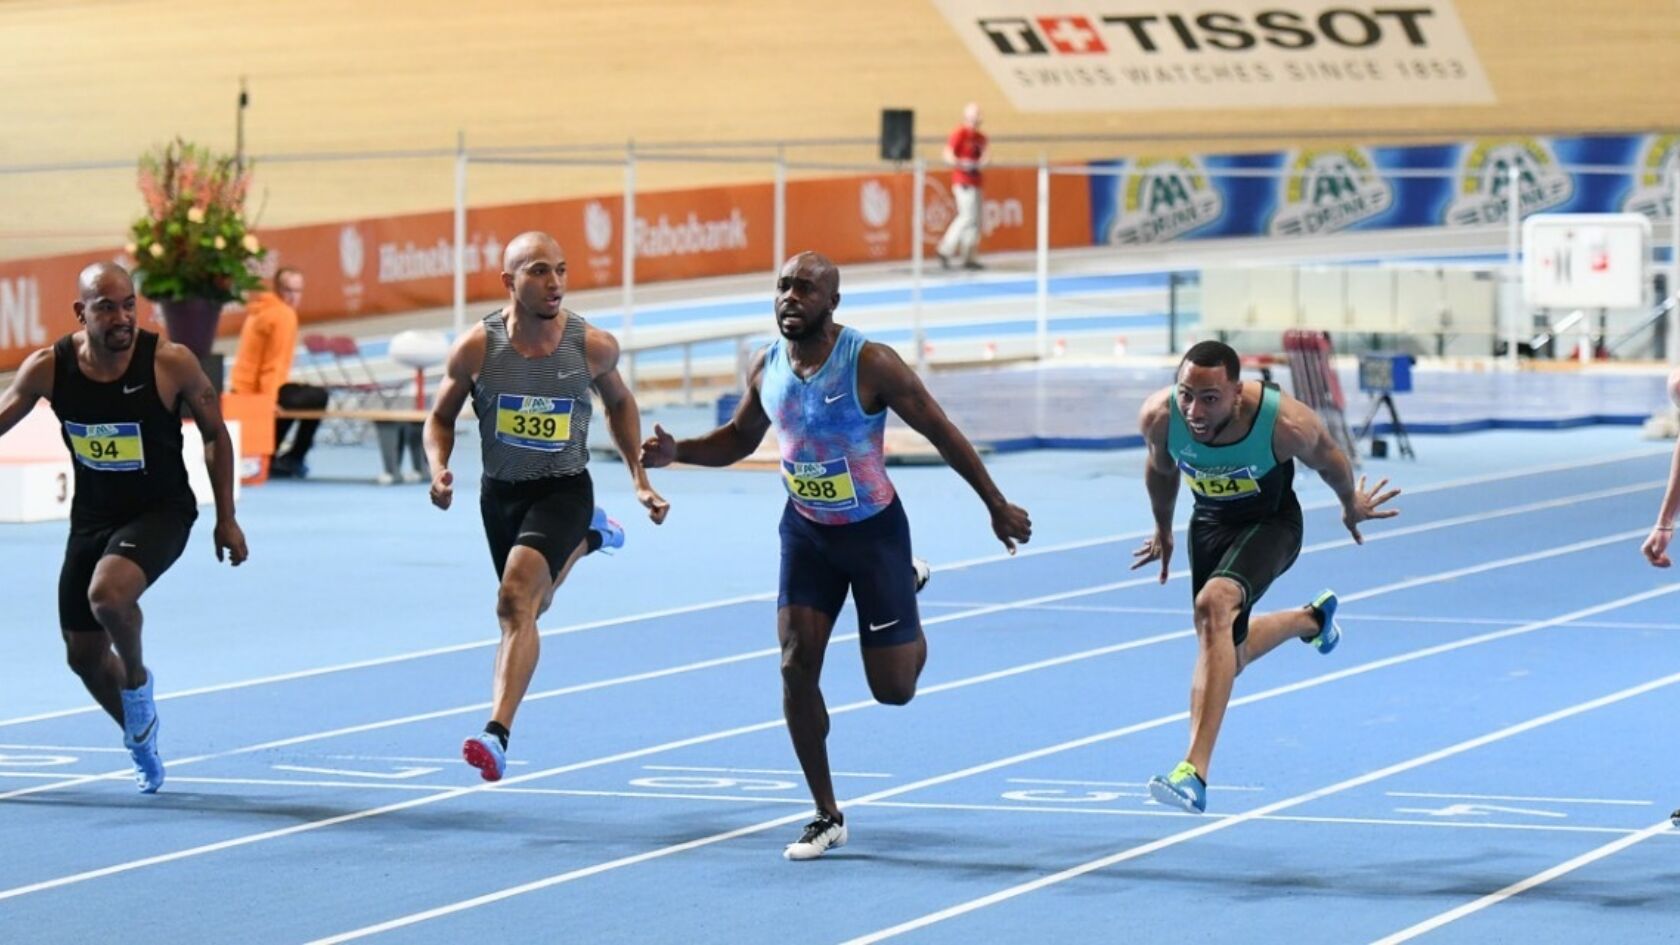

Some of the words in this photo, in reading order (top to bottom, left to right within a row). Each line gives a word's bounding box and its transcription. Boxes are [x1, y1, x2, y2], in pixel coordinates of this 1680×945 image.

[1102, 8, 1433, 52] TISSOT
[1013, 67, 1116, 87] SWISS
[1123, 62, 1274, 84] WATCHES
[1285, 60, 1382, 82] SINCE
[1396, 59, 1467, 80] 1853
[1148, 173, 1190, 215] AA
[633, 207, 748, 258] Rabobank
[981, 197, 1023, 237] pn
[378, 236, 481, 284] Heinekn
[0, 274, 47, 351] NL
[512, 415, 557, 438] 339
[90, 440, 119, 459] 94
[793, 479, 837, 499] 298
[1195, 479, 1240, 494] 154
